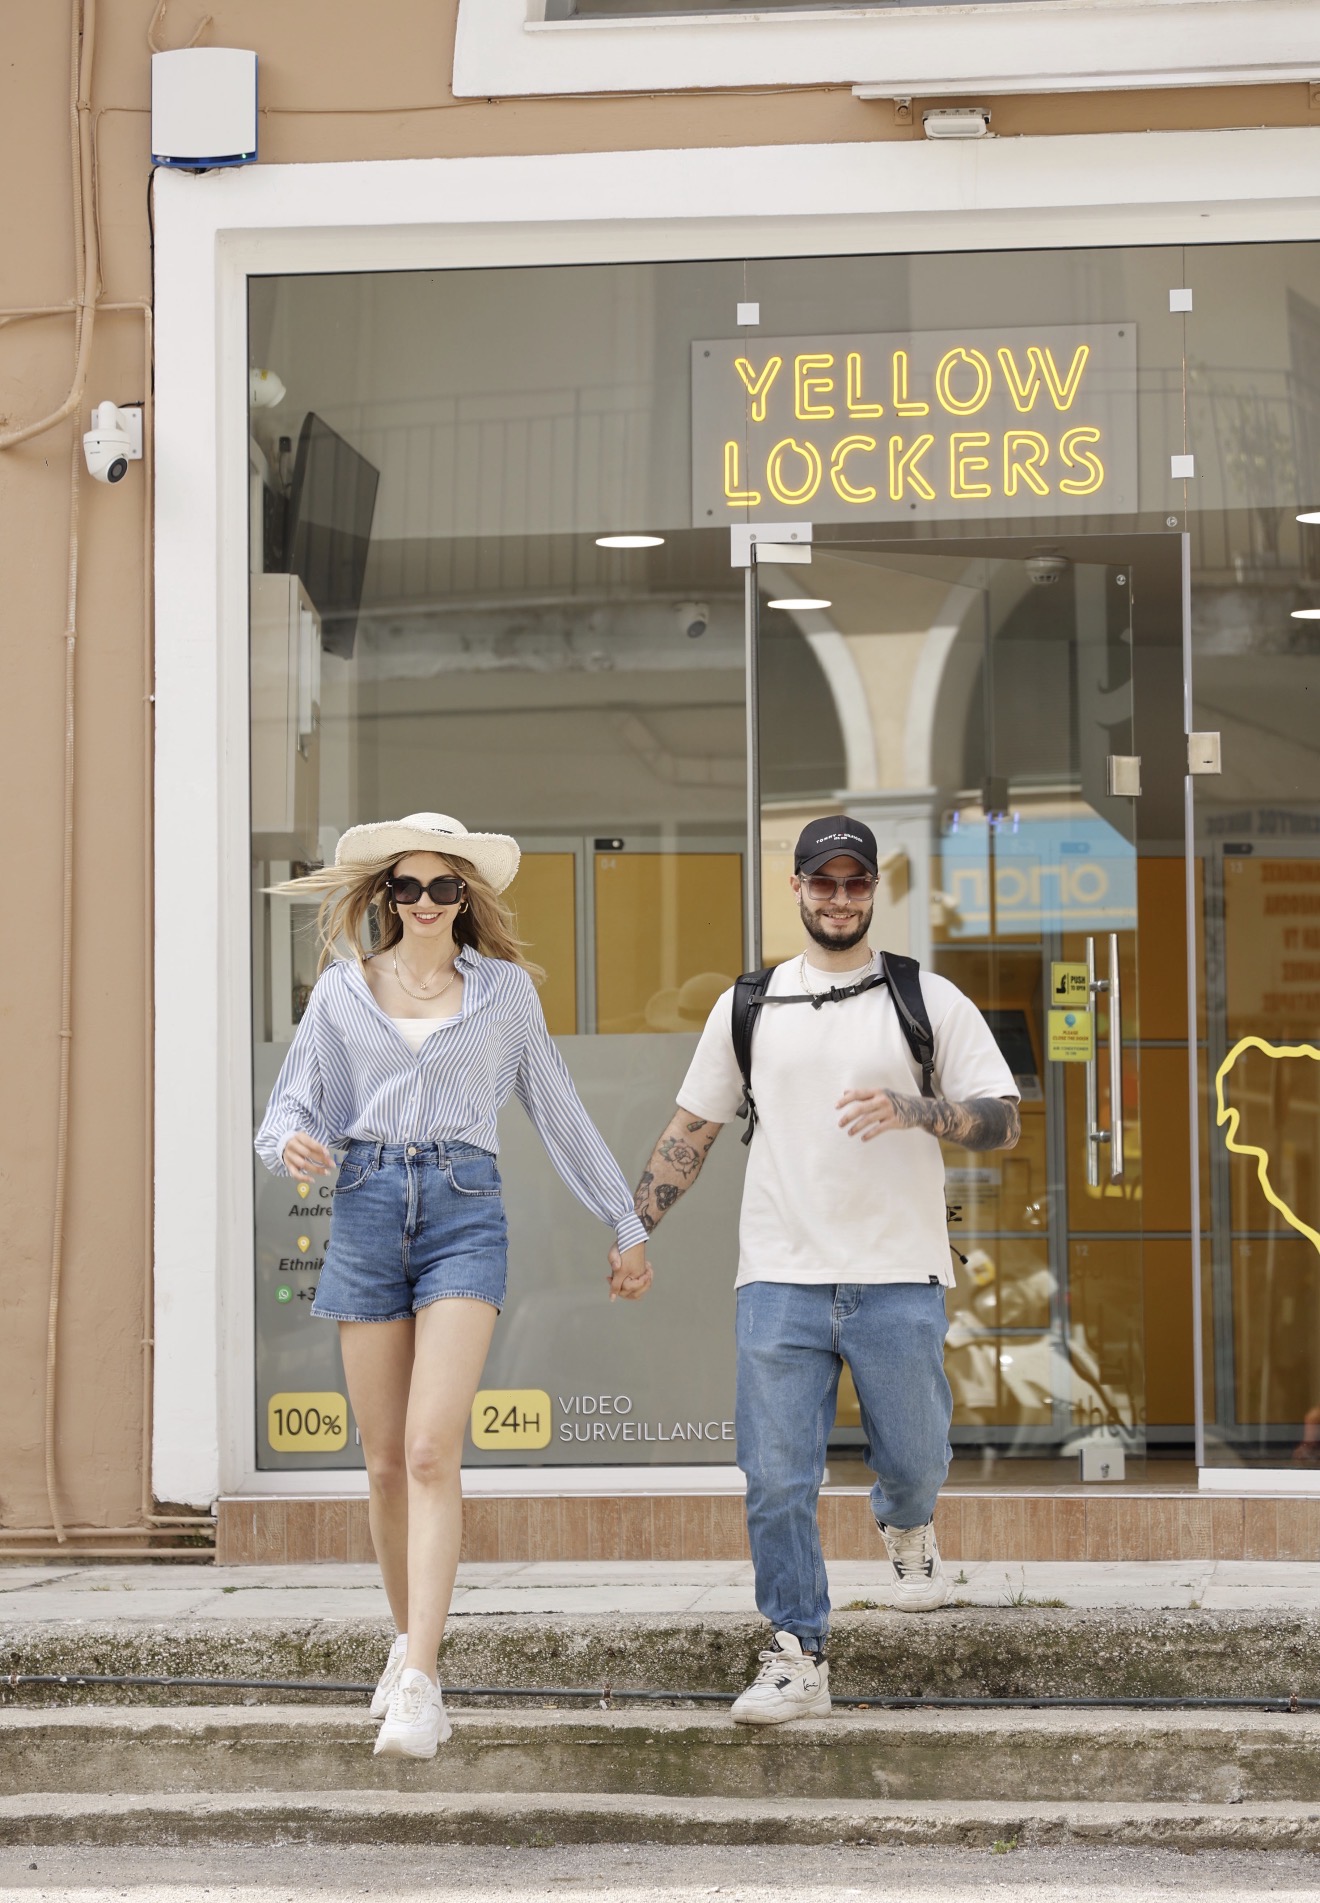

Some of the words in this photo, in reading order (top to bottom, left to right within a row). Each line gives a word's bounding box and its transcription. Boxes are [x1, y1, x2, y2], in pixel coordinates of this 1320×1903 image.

[734, 345, 1089, 421] YELLOW
[724, 427, 1104, 506] LOCKERS
[288, 1204, 333, 1217] Andre
[278, 1258, 325, 1271] Ethnik
[296, 1287, 316, 1301] +3
[558, 1395, 632, 1415] VIDEO
[273, 1408, 342, 1436] 100%
[483, 1405, 540, 1434] 24H
[559, 1421, 736, 1442] SURVEILLANCE
